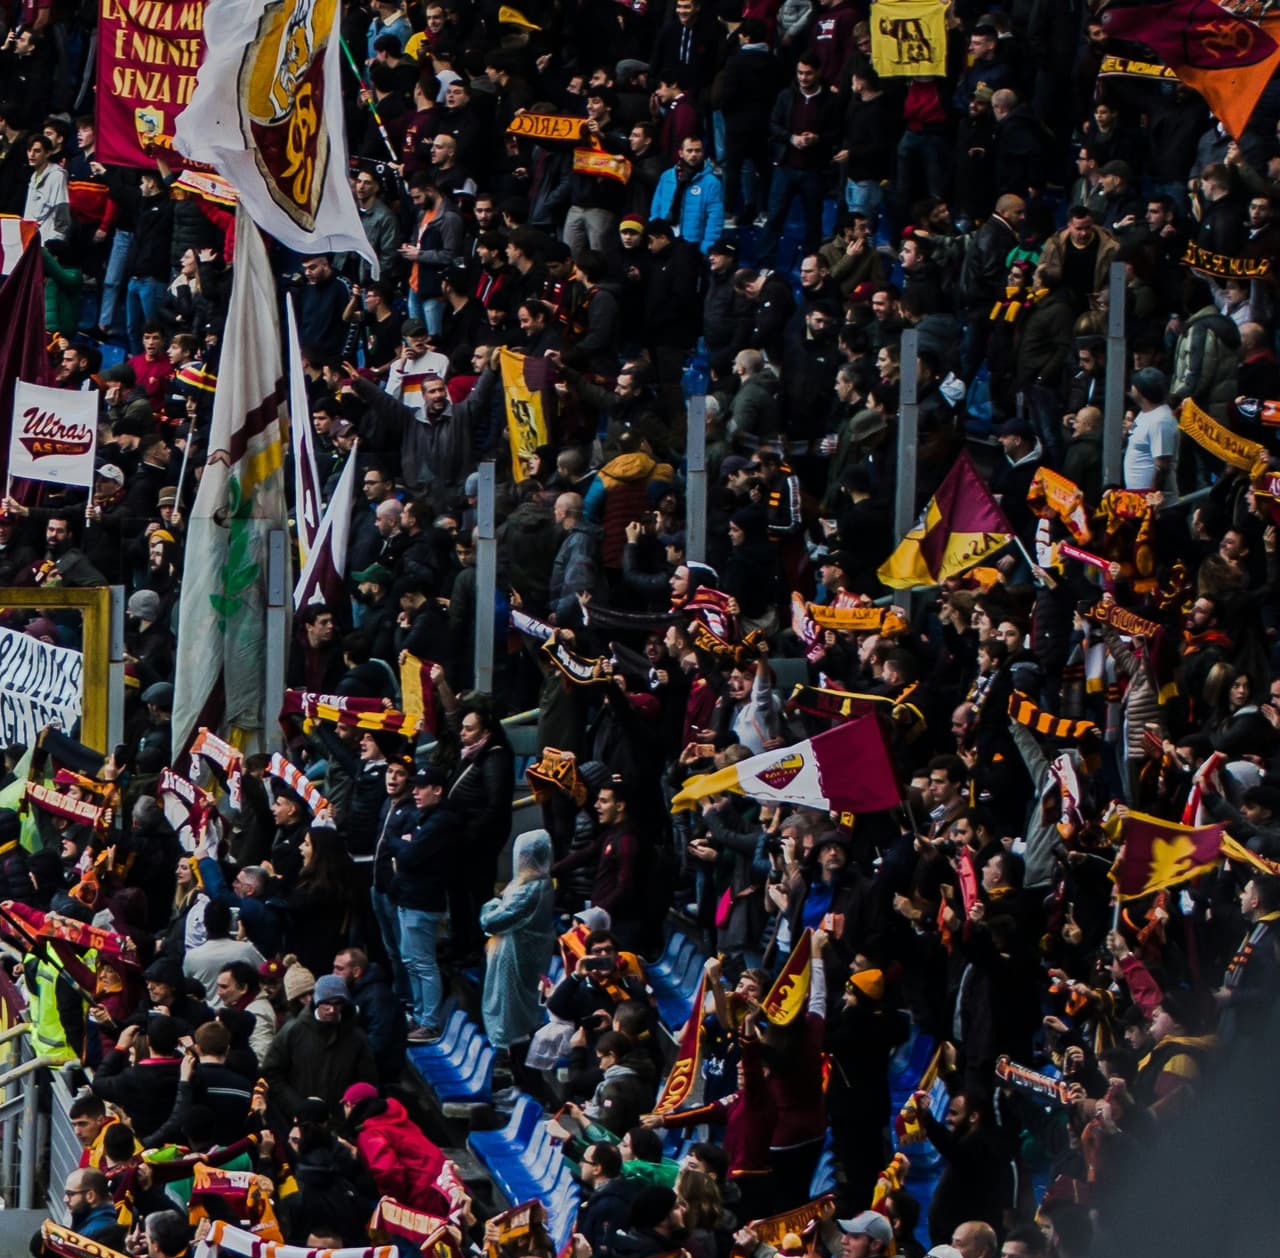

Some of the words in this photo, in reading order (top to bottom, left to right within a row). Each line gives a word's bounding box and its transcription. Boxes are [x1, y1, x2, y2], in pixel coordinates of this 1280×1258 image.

[130, 34, 200, 67] NIENTE
[111, 64, 171, 105] SENZA
[22, 406, 92, 441] Ultras
